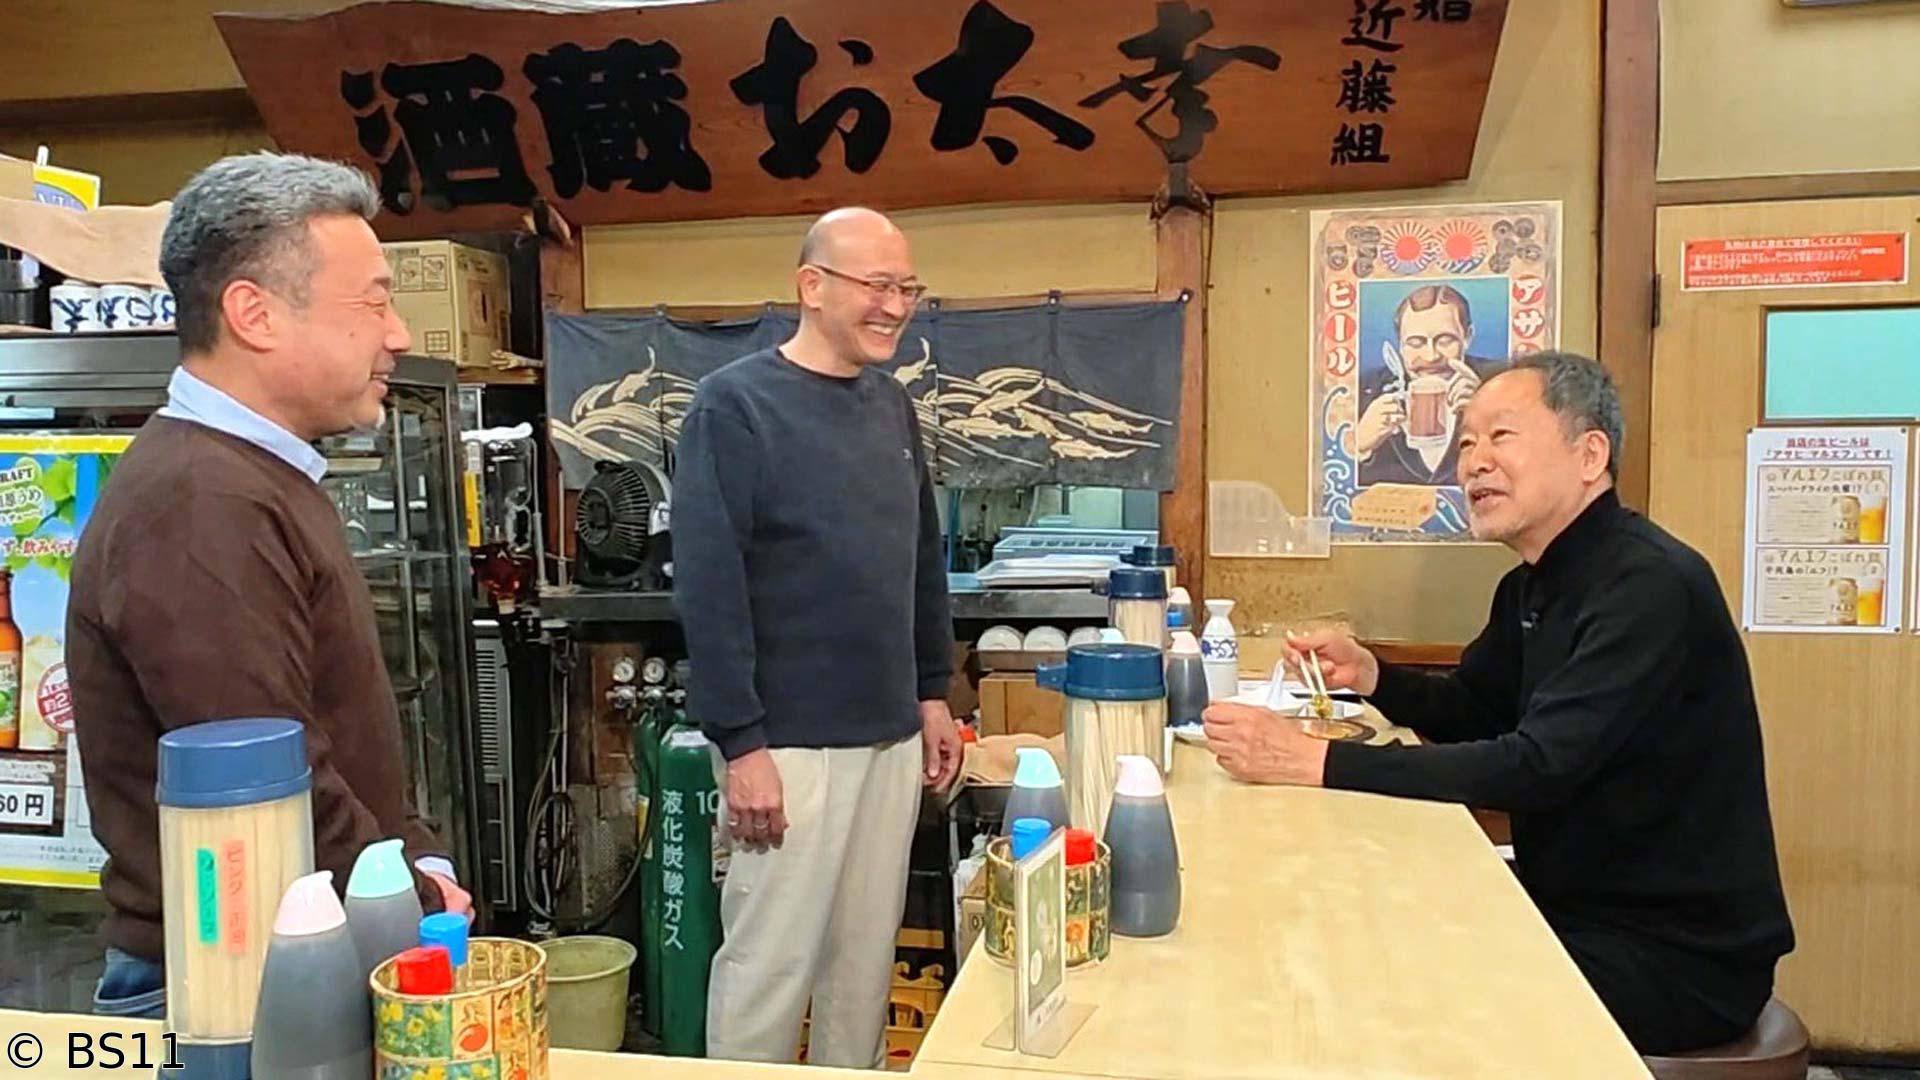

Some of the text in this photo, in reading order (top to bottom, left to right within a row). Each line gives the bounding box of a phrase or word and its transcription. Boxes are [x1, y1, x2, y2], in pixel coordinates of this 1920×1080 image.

[1330, 0, 1405, 165] 近藤組
[1326, 280, 1356, 376] ビール
[1786, 437, 1870, 448] 当店の生ビールは
[662, 788, 685, 951] 液化炭酸ガス
